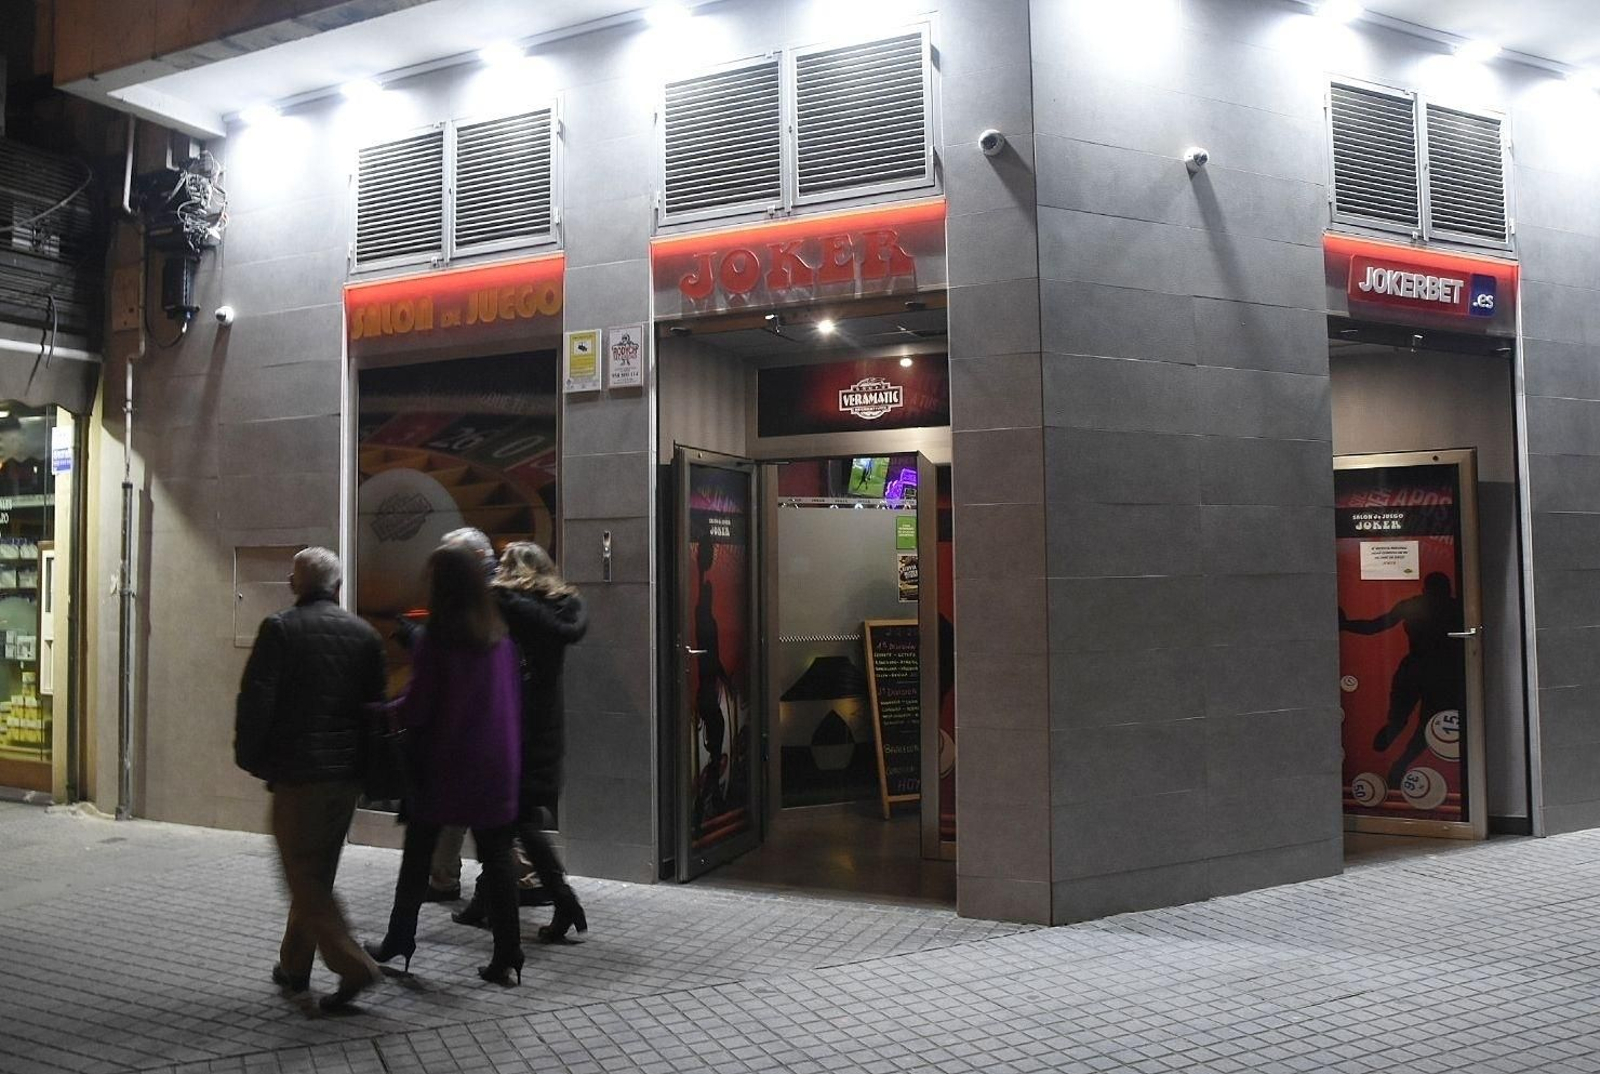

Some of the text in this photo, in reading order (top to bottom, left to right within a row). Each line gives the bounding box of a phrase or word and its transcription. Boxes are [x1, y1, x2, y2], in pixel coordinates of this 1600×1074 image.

[679, 229, 916, 299] JOKER
[466, 281, 563, 325] JUEGO
[1358, 266, 1494, 309] JOKERBET .es
[843, 391, 899, 406] VERAMATIC
[1355, 521, 1401, 530] JOKER
